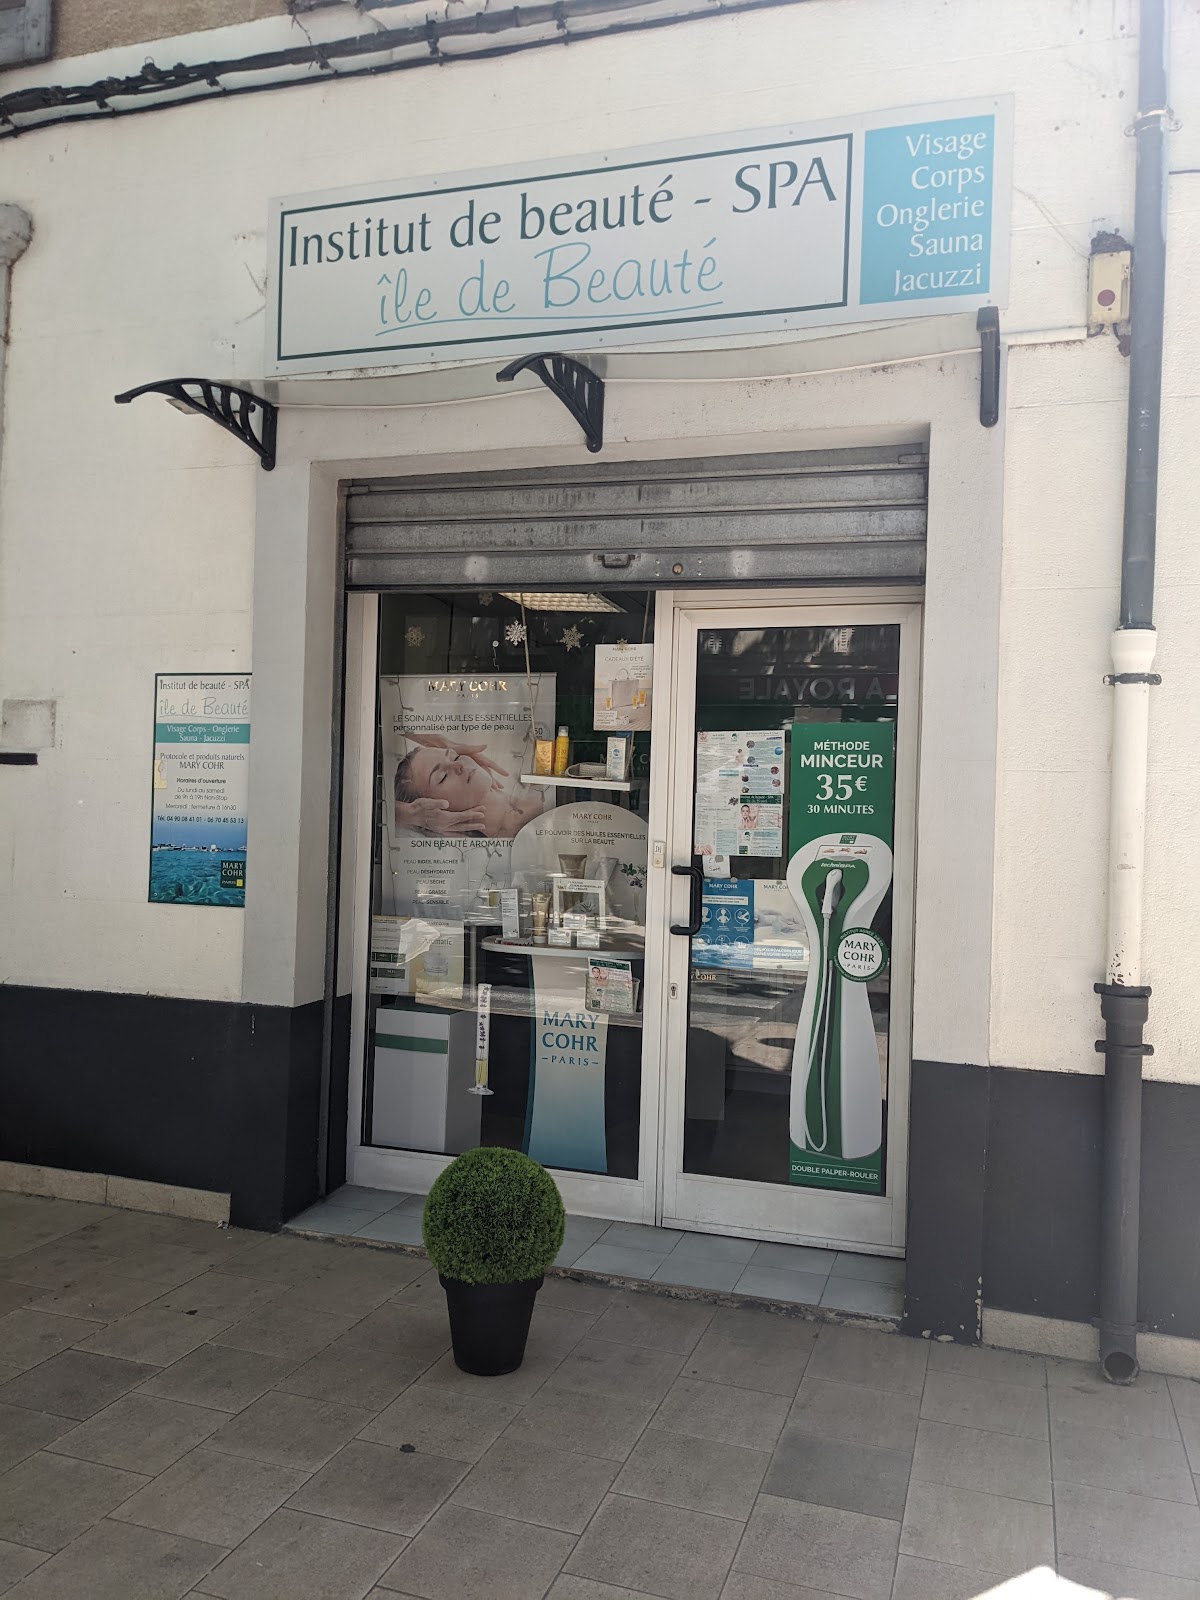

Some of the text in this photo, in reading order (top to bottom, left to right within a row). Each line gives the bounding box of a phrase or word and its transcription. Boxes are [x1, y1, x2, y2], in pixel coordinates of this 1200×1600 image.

[906, 129, 987, 158] Visage
[911, 164, 985, 193] Corps
[289, 156, 837, 267] Institut de beauté - SPA
[876, 195, 985, 230] Onglerie
[909, 232, 983, 258] Sauna
[377, 237, 724, 326] île de Beauté
[893, 264, 981, 297] Jacuzzi
[160, 680, 186, 690] Institut
[188, 680, 198, 690] de
[200, 680, 226, 690] beauté
[233, 680, 250, 690] SPA
[469, 680, 508, 692] COHR
[160, 696, 249, 715] île de Beauté
[404, 714, 425, 722] SOIN
[425, 714, 444, 722] AUX
[445, 714, 474, 722] HUILES
[475, 714, 532, 722] ESSENTIELLES
[166, 725, 186, 735] Visage
[188, 725, 207, 734] Corps
[212, 725, 240, 735] Onglerie
[393, 723, 515, 733] personnalisé par type de peau
[813, 739, 870, 751] MÉTHODE
[196, 753, 220, 763] produits
[800, 754, 883, 768] MINCEUR
[202, 762, 225, 770] COHR
[815, 774, 868, 801] 35€
[807, 804, 875, 815] 30 MINUTES
[607, 832, 646, 840] ESSENTIELLES
[410, 840, 432, 848] SOIN
[433, 838, 468, 848] BEAUTÉ
[222, 862, 244, 870] MARY
[222, 869, 244, 877] COHR
[422, 937, 453, 946] Aromatic
[844, 939, 877, 951] MARY
[843, 951, 876, 963] COHR
[542, 1010, 600, 1030] MARY
[542, 1032, 599, 1052] COHR
[791, 1164, 879, 1180] DOUBLE PALPER-ROULER
